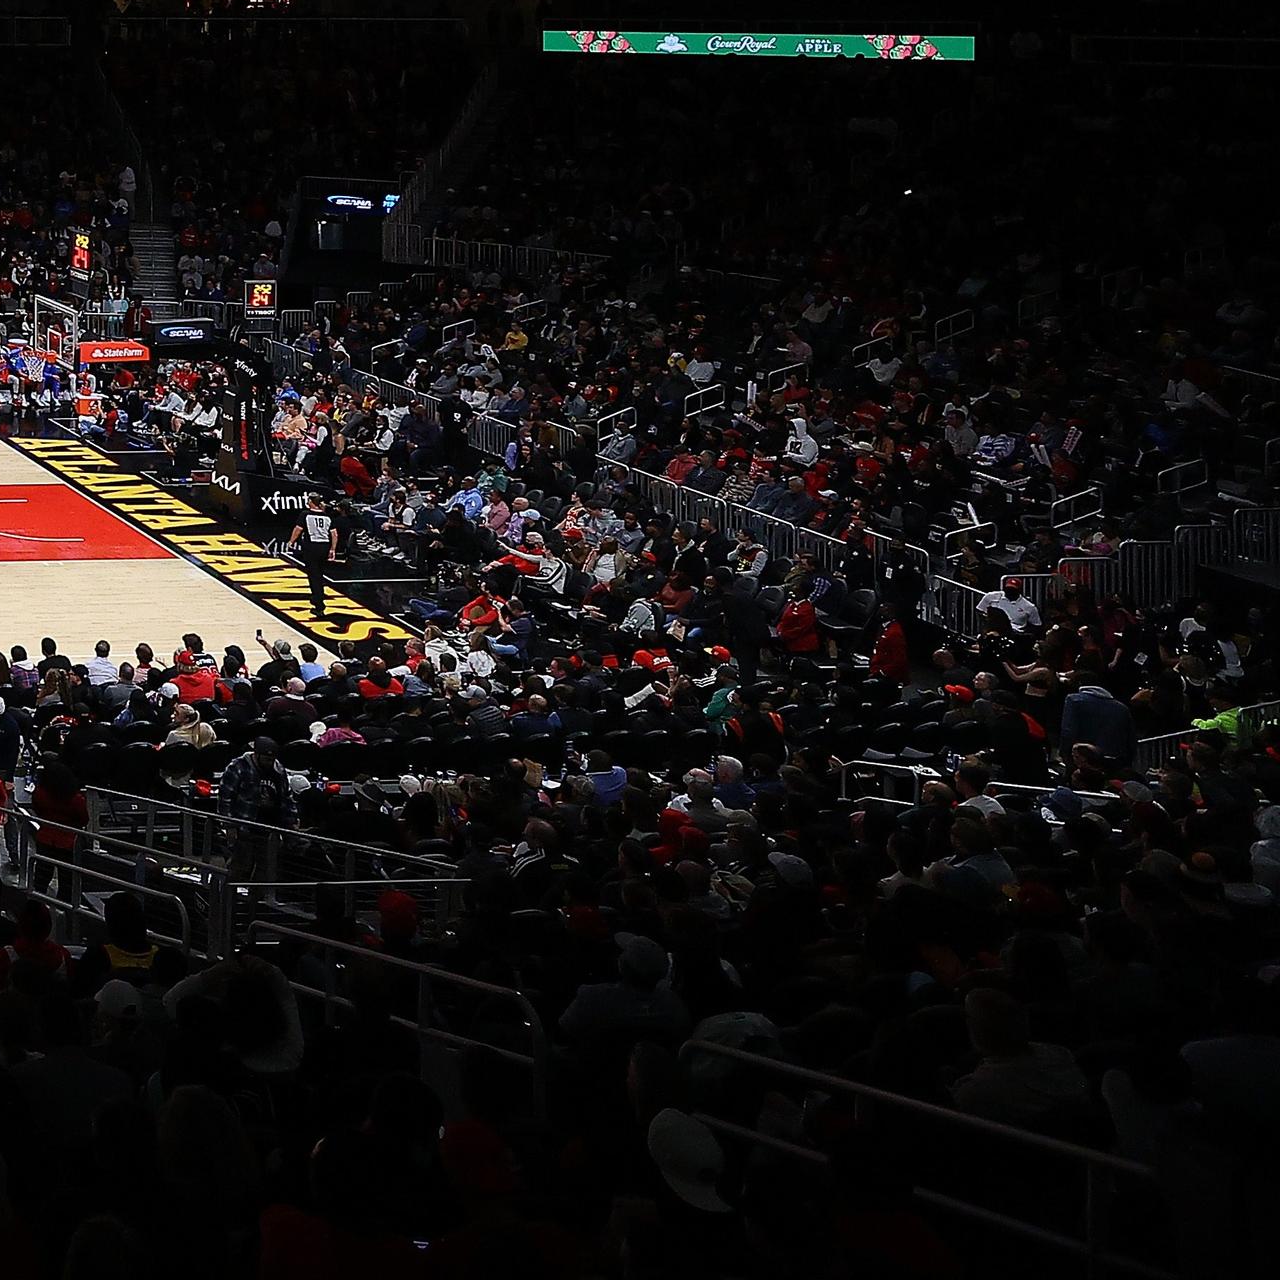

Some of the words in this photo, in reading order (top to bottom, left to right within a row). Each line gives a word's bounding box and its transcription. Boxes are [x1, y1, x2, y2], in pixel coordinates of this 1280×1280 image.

[795, 42, 842, 54] APPLE
[73, 246, 88, 269] 24
[168, 329, 204, 338] SCANA
[260, 490, 310, 515] xfinit
[314, 517, 324, 528] 18
[6, 436, 218, 531] ATLANTA
[161, 532, 413, 641] HAWKS
